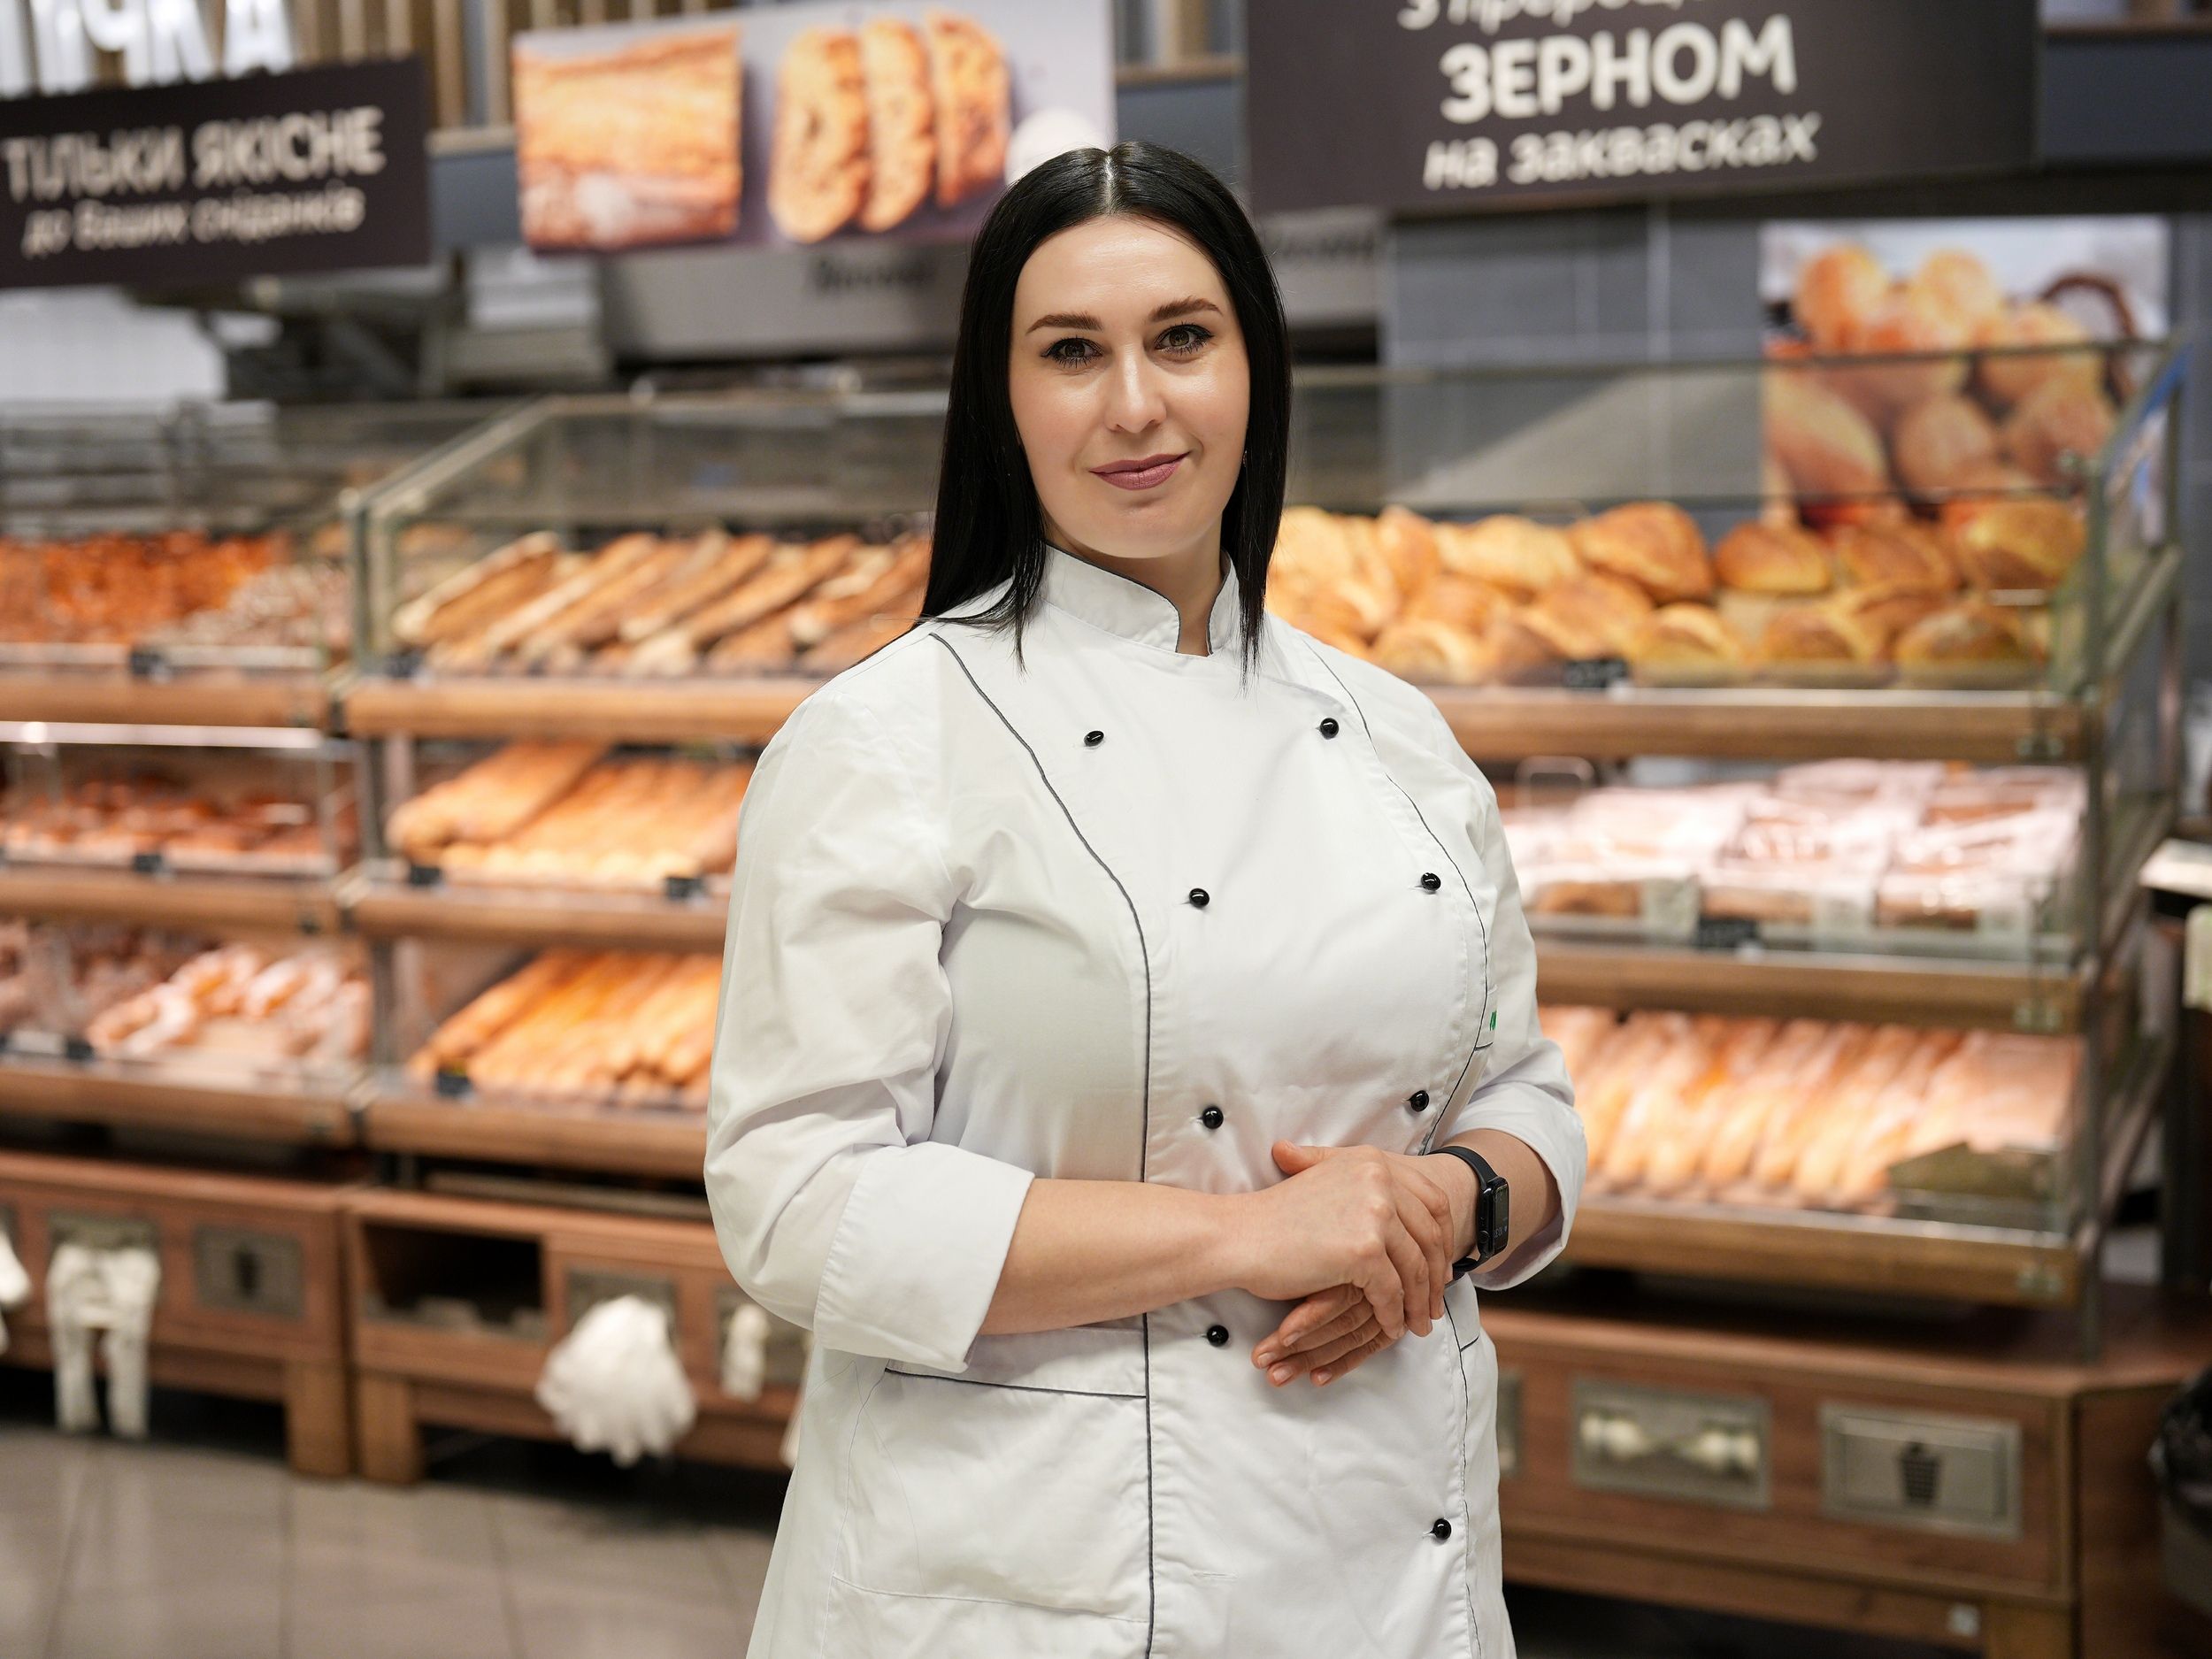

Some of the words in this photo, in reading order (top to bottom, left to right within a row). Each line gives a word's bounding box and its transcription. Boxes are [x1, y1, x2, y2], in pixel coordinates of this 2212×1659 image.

[1440, 14, 1798, 124] ЗЕРНОМ
[193, 106, 387, 188] ЯКІСНЕ
[1424, 138, 1499, 190] на
[1507, 112, 1822, 185] заквасках
[22, 210, 71, 259] до
